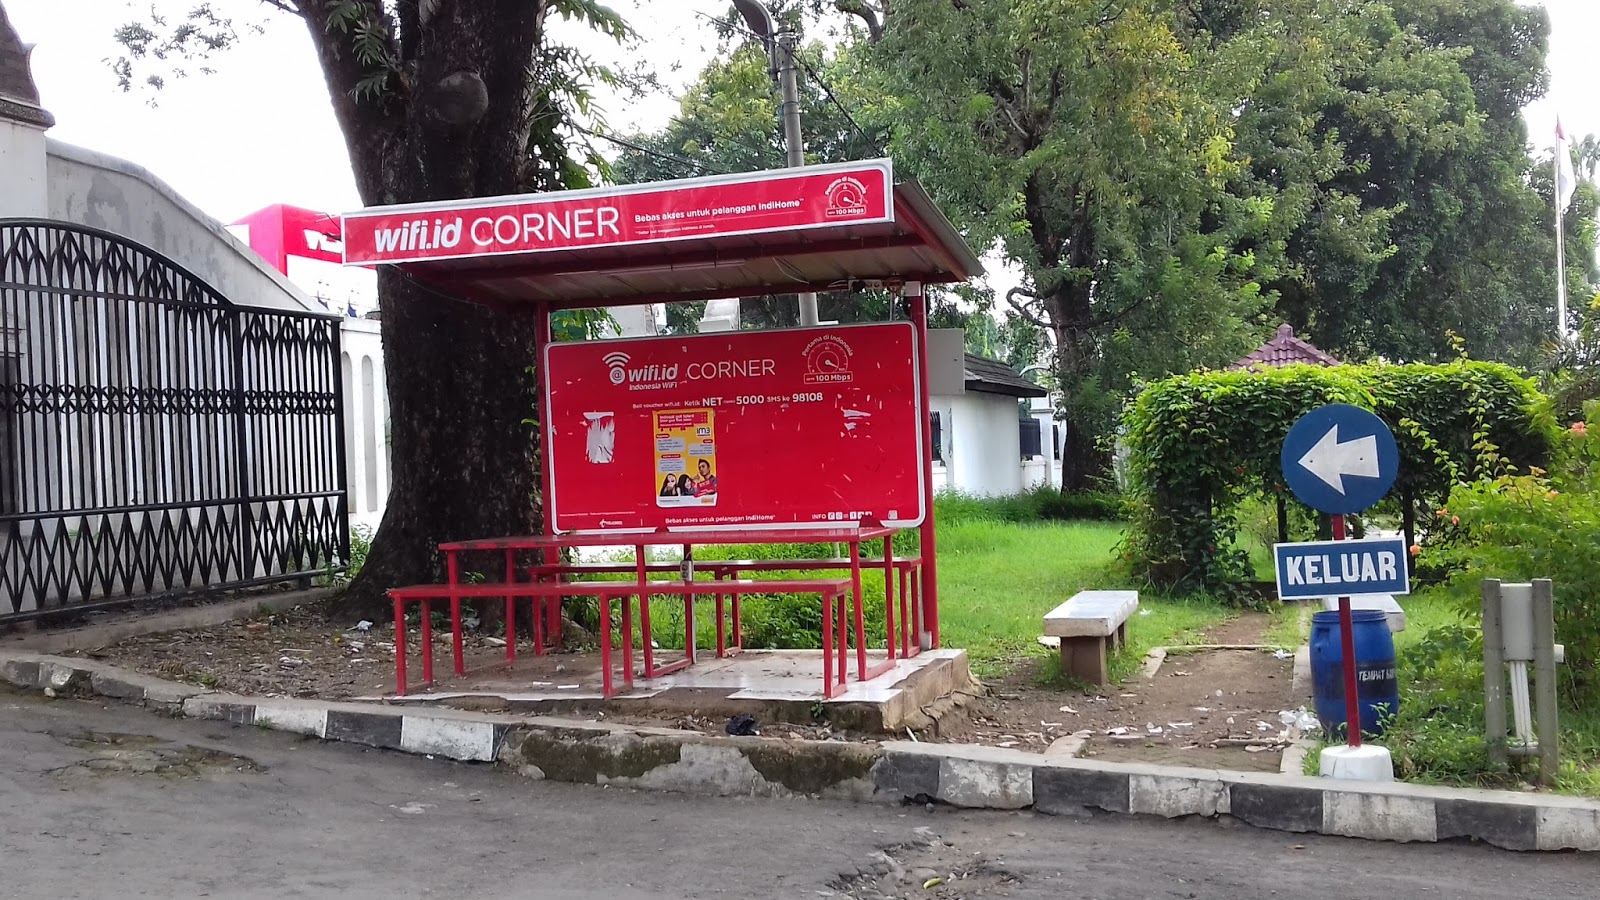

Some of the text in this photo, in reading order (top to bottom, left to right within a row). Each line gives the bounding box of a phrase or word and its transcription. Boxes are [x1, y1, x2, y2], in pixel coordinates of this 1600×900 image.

[634, 213, 661, 223] Bebas
[662, 210, 685, 220] akses
[686, 207, 711, 218] untuk
[711, 205, 757, 217] pelanggan
[847, 207, 864, 215] Mbps
[374, 217, 463, 253] wifi.id
[470, 207, 620, 247] CORNER
[801, 336, 823, 357] Pertama
[830, 335, 854, 357] Indonesia
[628, 363, 679, 382] wifi.id
[687, 359, 776, 380] CORNER
[830, 374, 851, 382] Mbps
[629, 383, 661, 391] Indonesia
[684, 399, 701, 407] Ketik
[702, 397, 723, 407] NET
[735, 395, 765, 405] 5000
[792, 392, 823, 403] 98108
[699, 515, 715, 523] untuk
[715, 515, 745, 523] pelanggan
[1286, 551, 1397, 585] KELUAR
